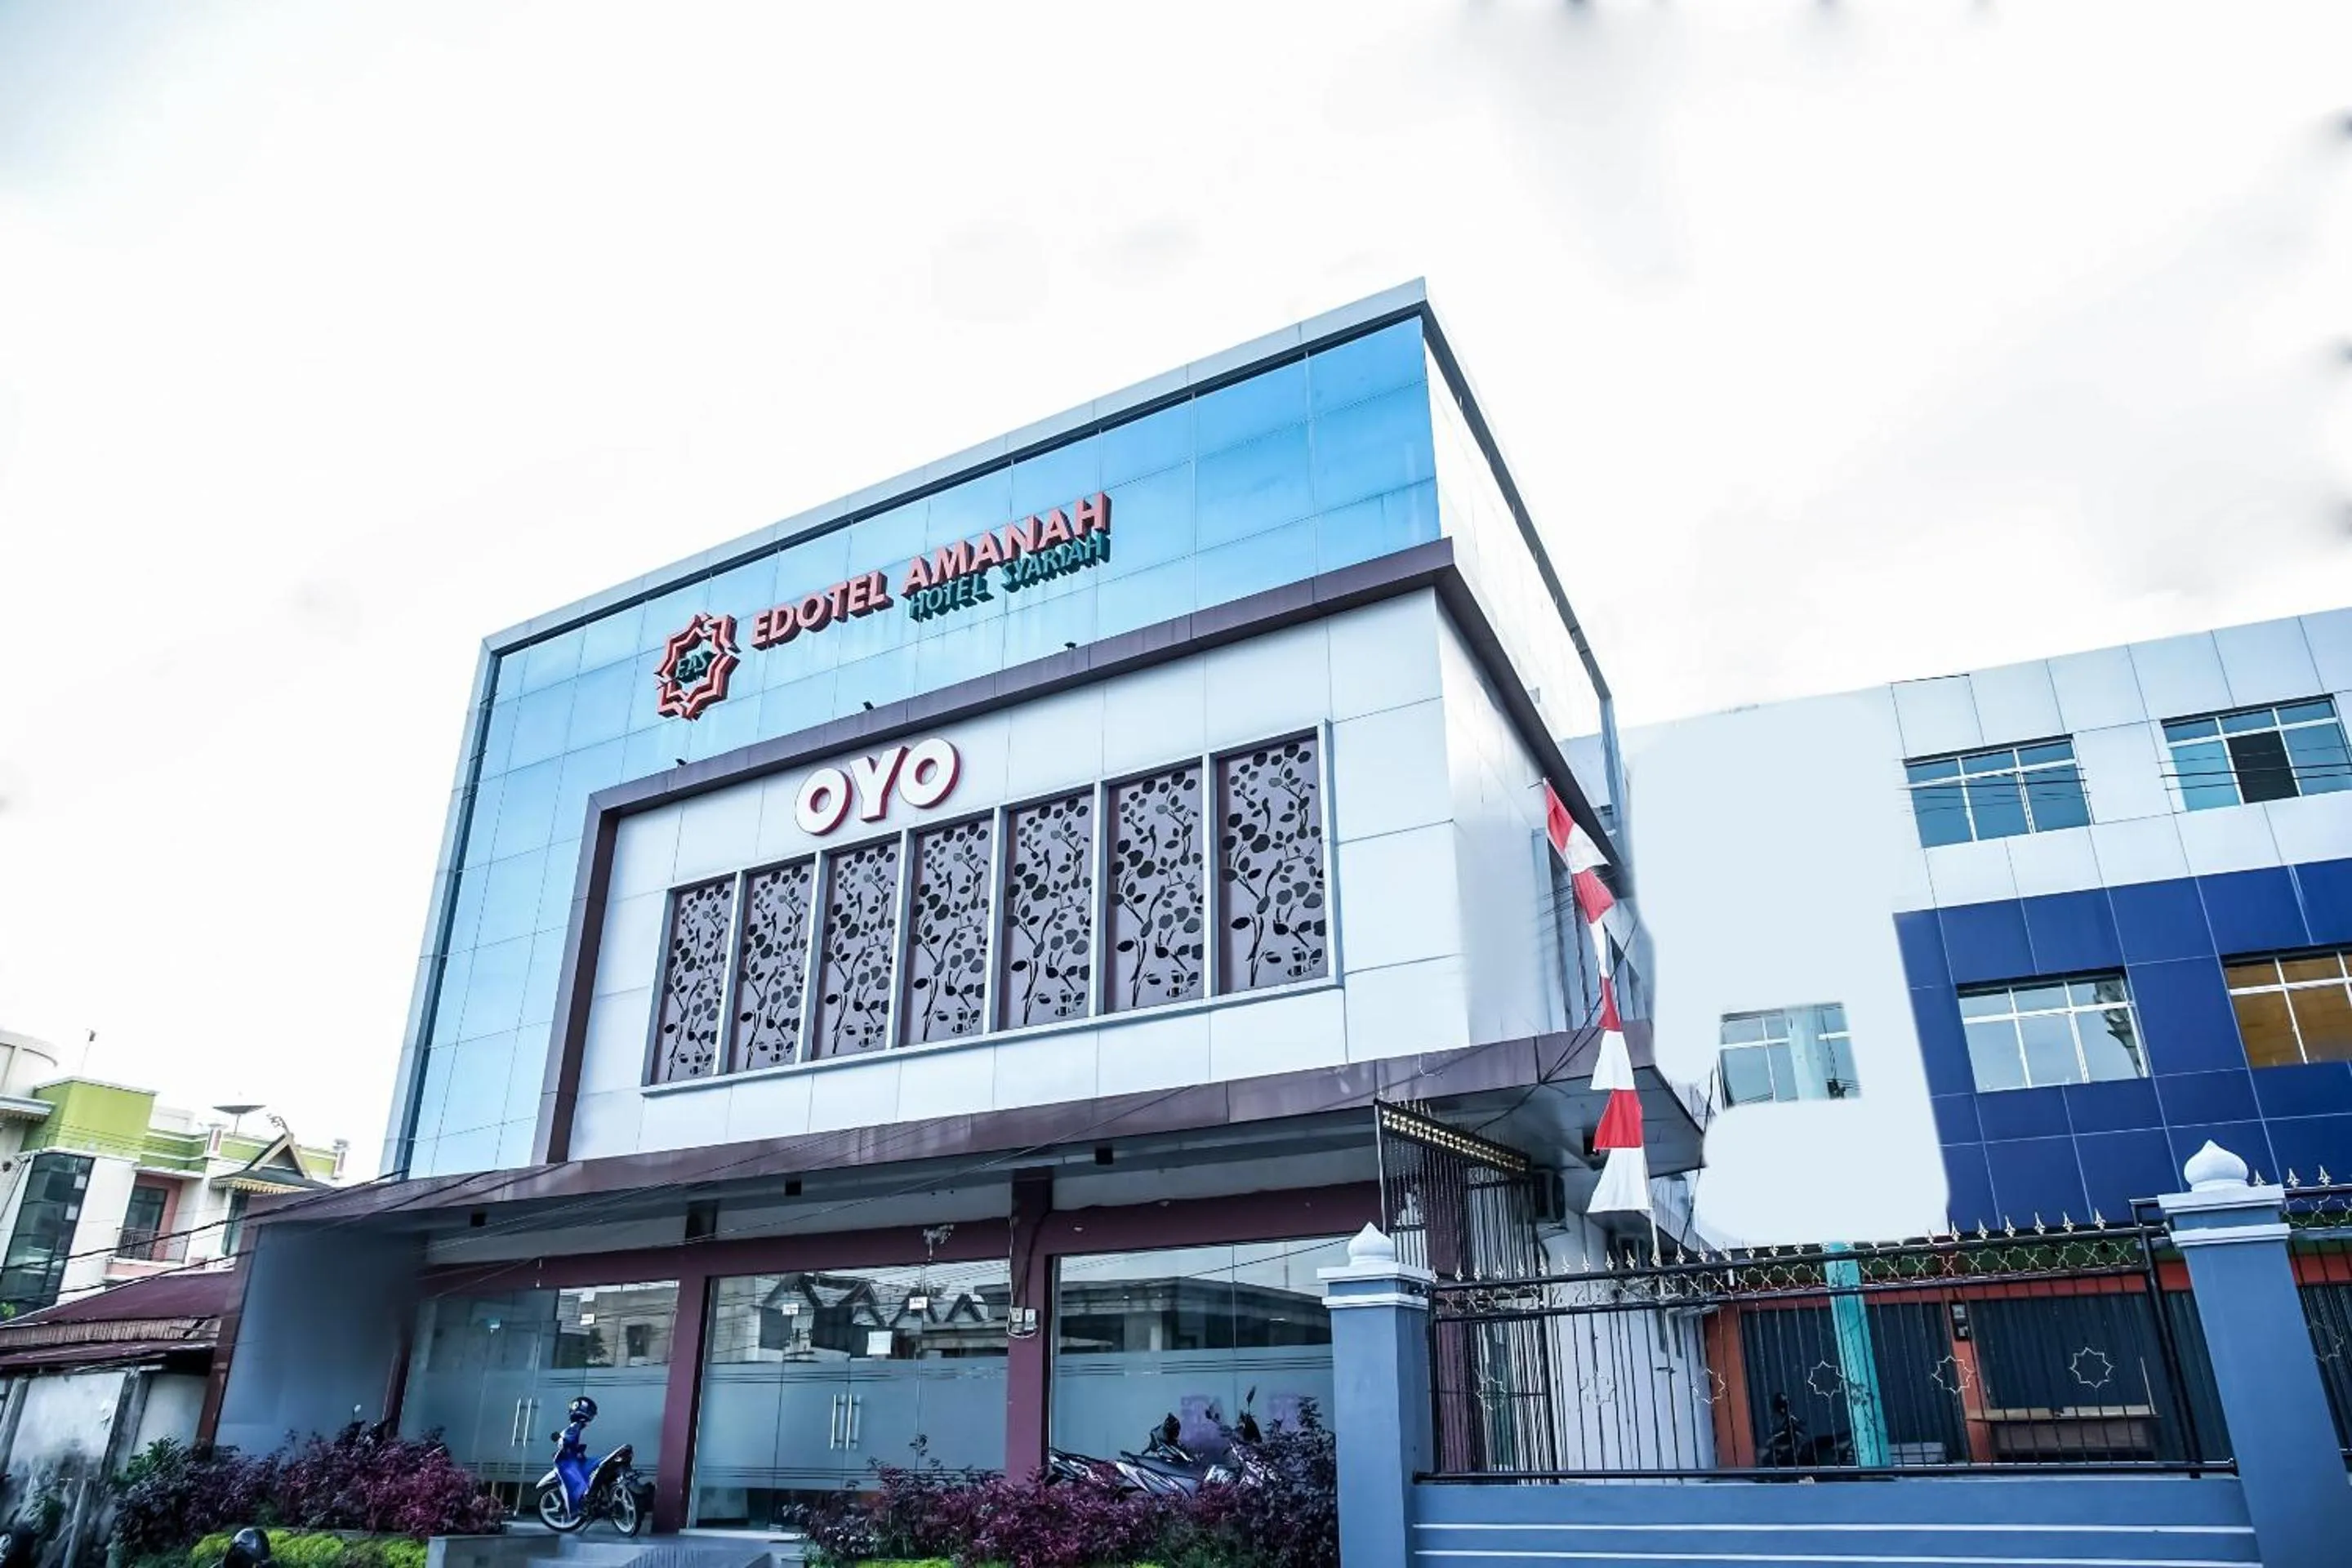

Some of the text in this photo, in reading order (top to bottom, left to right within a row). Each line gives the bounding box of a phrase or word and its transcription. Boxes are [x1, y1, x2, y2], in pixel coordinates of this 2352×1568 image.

[751, 492, 1110, 648] EDOTEL AMANAH
[909, 533, 1109, 620] HOTEL SYARIAH
[795, 738, 960, 835] OYO
